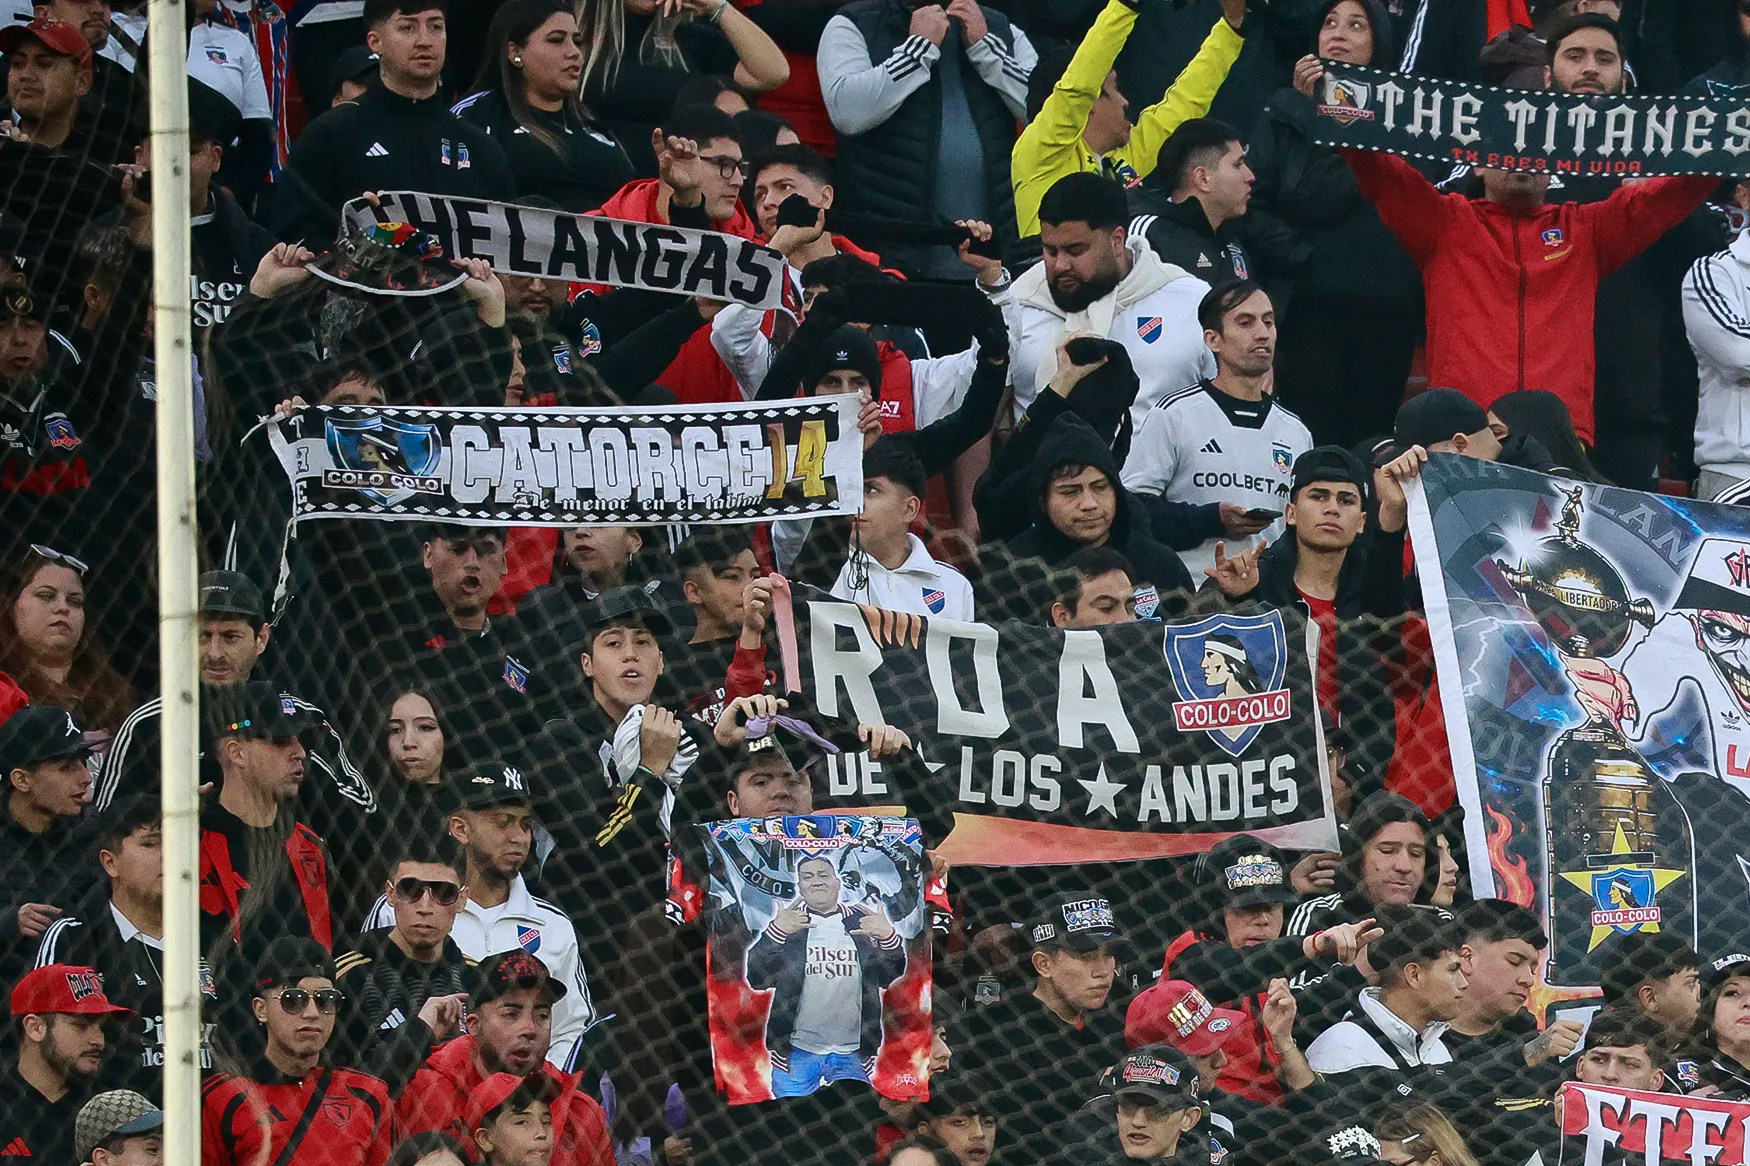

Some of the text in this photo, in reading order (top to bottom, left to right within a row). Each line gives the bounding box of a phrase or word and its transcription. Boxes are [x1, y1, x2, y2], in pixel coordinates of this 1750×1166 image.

[1376, 79, 1484, 146] THE
[1556, 158, 1581, 172] MI
[1590, 160, 1642, 174] VIDA
[505, 207, 783, 304] LANGAS
[449, 420, 827, 505] CATORCE 14
[327, 471, 440, 493] COLO COLO
[1193, 472, 1275, 494] COOLBET
[562, 494, 630, 511] menor
[643, 495, 667, 511] en
[677, 492, 699, 509] el
[1180, 694, 1289, 730] COLO-COLO
[959, 746, 1063, 812] LOS
[1138, 755, 1299, 823] ANDES
[785, 837, 840, 850] COLO-COLO
[1594, 909, 1659, 924] COLO-COLO
[825, 961, 857, 978] Sur
